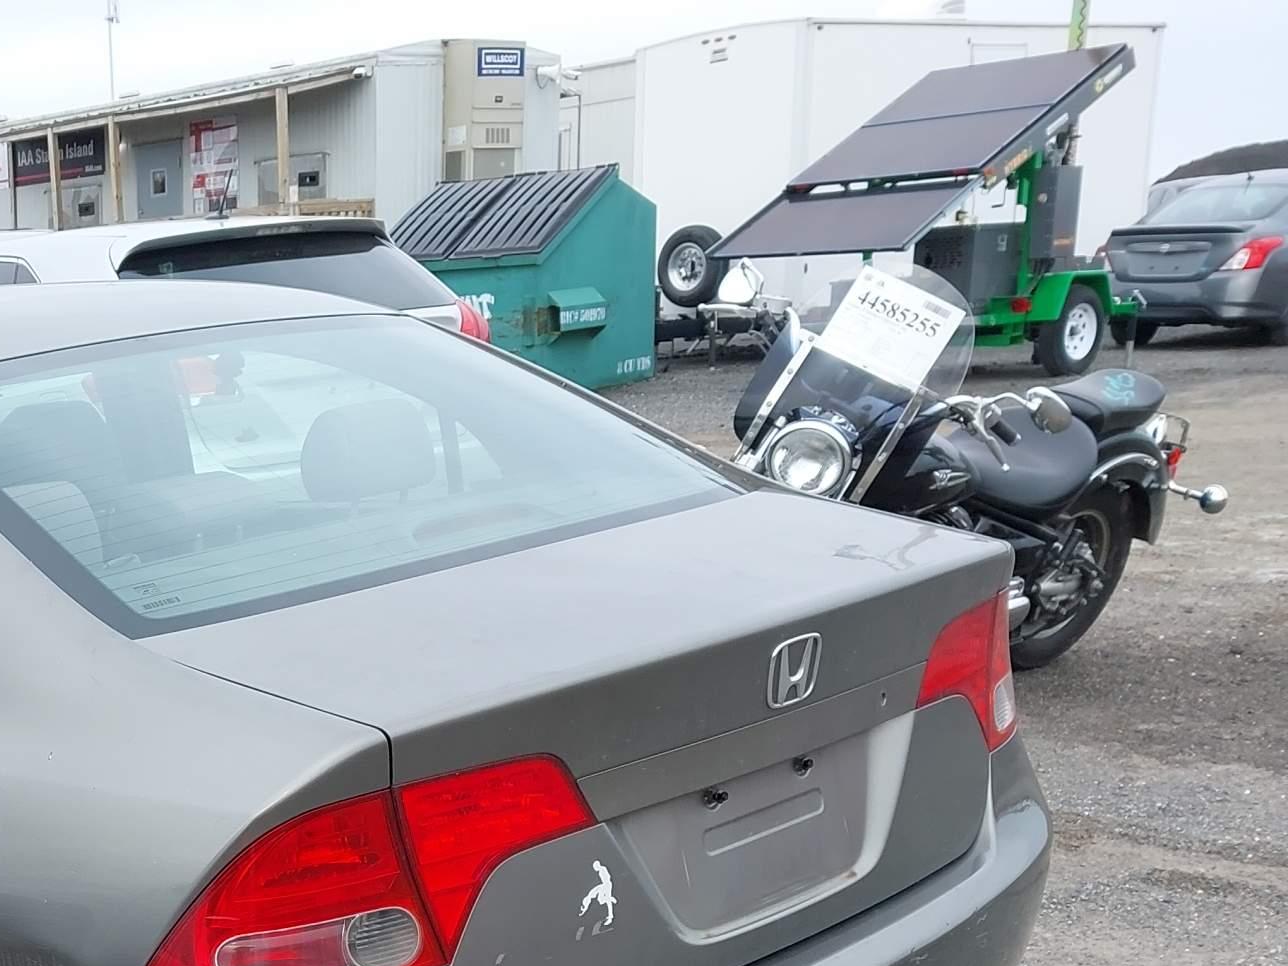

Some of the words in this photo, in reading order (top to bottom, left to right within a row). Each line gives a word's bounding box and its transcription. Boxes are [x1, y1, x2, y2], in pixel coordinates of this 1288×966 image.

[17, 150, 33, 167] IAA
[65, 139, 94, 159] Island
[858, 290, 942, 338] 44585255
